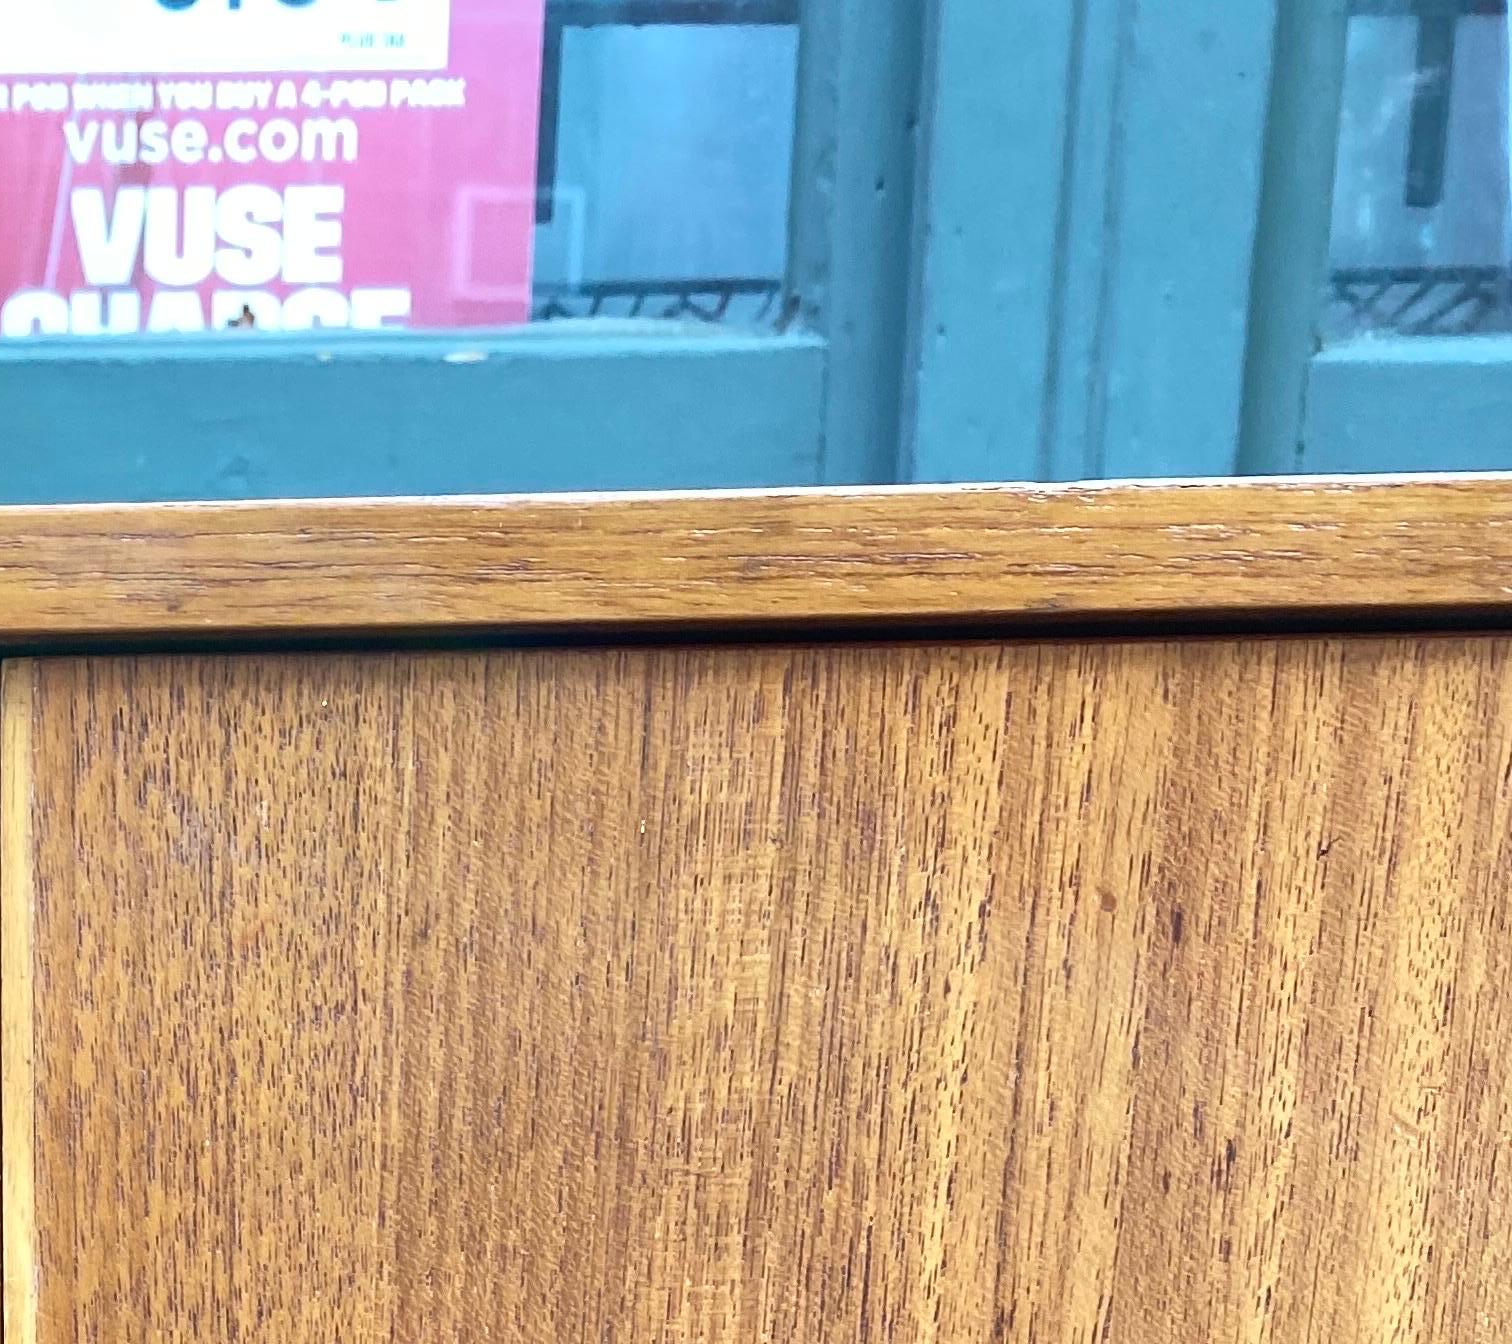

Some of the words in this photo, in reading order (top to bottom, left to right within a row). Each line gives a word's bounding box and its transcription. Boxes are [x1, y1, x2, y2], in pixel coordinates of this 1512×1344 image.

[157, 80, 214, 110] YOU
[275, 79, 298, 108] A
[65, 117, 357, 164] vuse.com
[70, 184, 345, 286] VUSE
